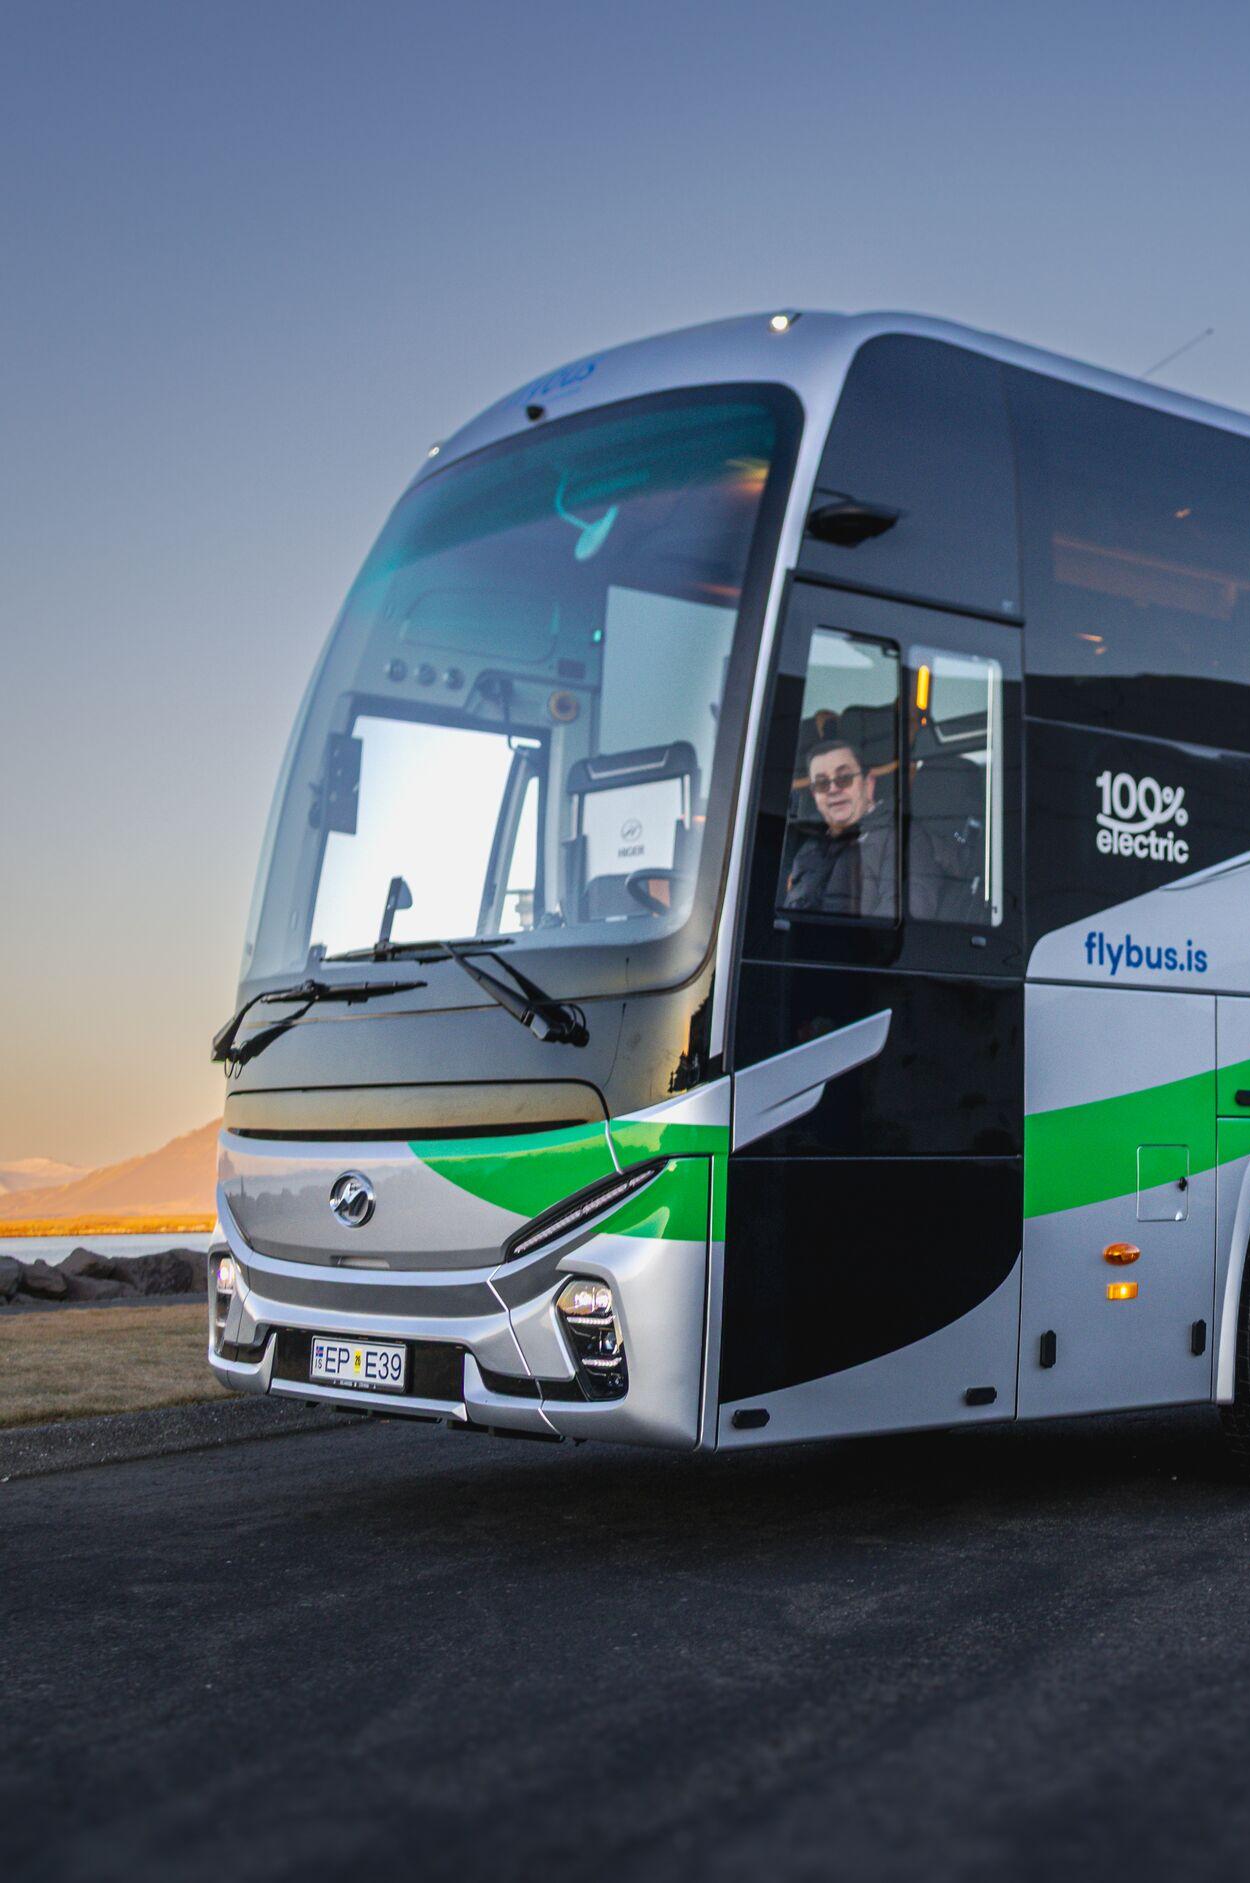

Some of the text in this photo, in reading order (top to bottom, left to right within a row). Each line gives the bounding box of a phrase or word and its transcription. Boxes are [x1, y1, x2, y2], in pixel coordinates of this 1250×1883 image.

[1096, 828, 1189, 864] electric
[1084, 931, 1208, 976] flybus.is
[315, 1358, 323, 1369] IS
[325, 1346, 350, 1373] EP
[365, 1351, 402, 1380] E39
